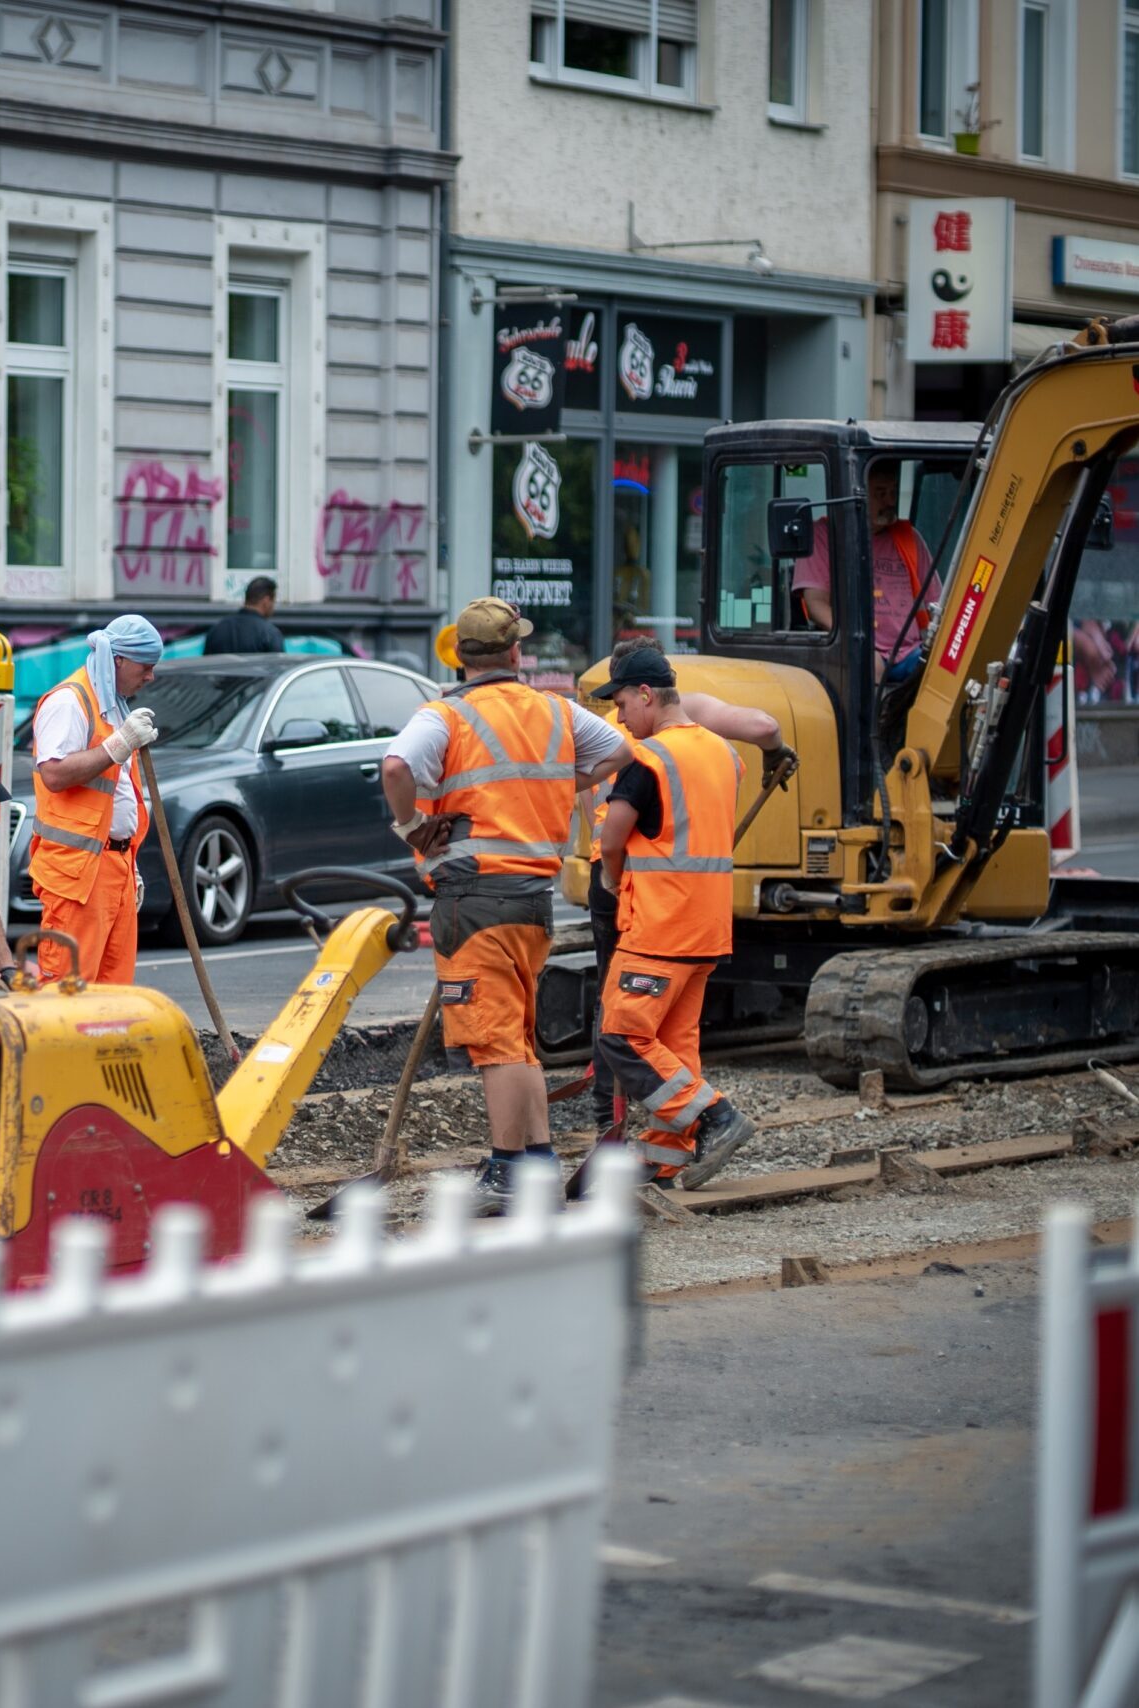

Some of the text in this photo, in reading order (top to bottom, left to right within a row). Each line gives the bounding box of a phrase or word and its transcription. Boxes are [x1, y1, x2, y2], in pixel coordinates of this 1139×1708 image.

[528, 469, 550, 510] 66
[493, 575, 573, 607] GEÖFFNET
[948, 597, 976, 660] ZEPPELIN
